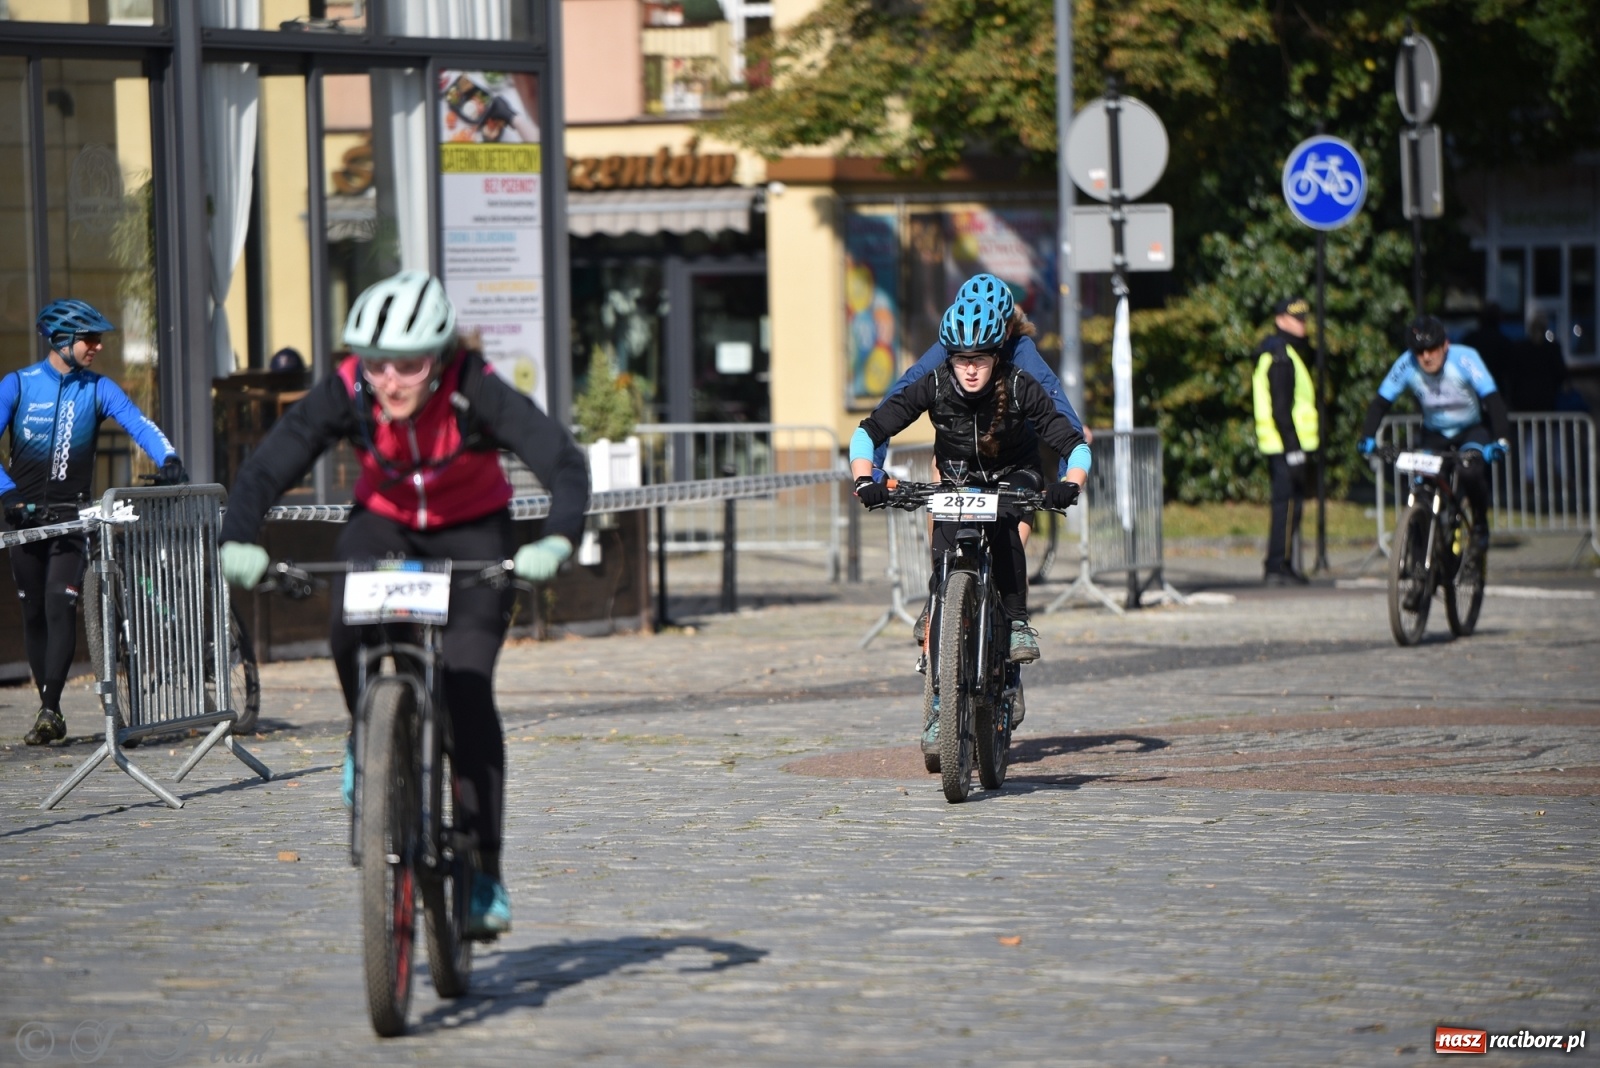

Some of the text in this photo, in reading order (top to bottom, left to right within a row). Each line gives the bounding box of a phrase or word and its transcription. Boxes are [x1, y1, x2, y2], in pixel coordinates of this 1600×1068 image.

[567, 136, 737, 191] zentów
[483, 177, 499, 193] BEZ
[943, 496, 986, 508] 2875
